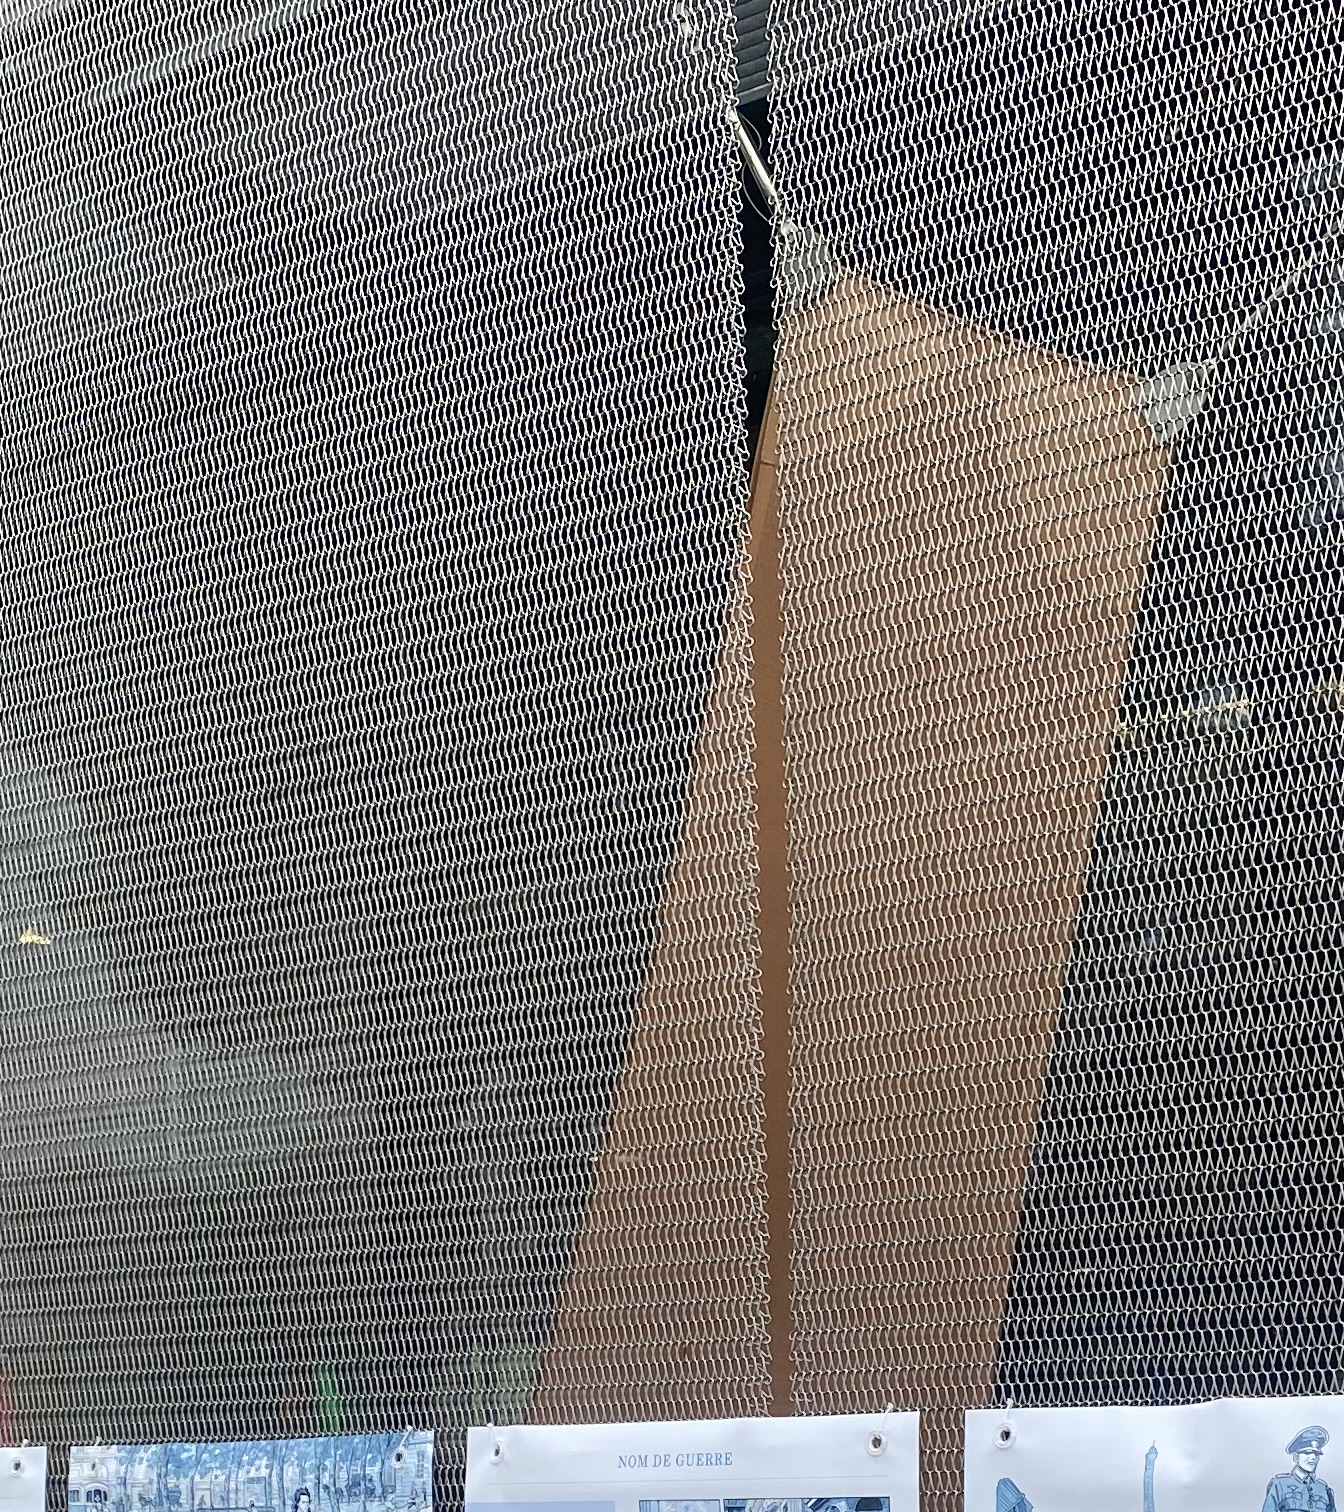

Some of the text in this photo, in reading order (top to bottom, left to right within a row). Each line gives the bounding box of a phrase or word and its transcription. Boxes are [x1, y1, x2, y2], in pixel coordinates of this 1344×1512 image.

[617, 1452, 735, 1468] NOM DE GUERRE
